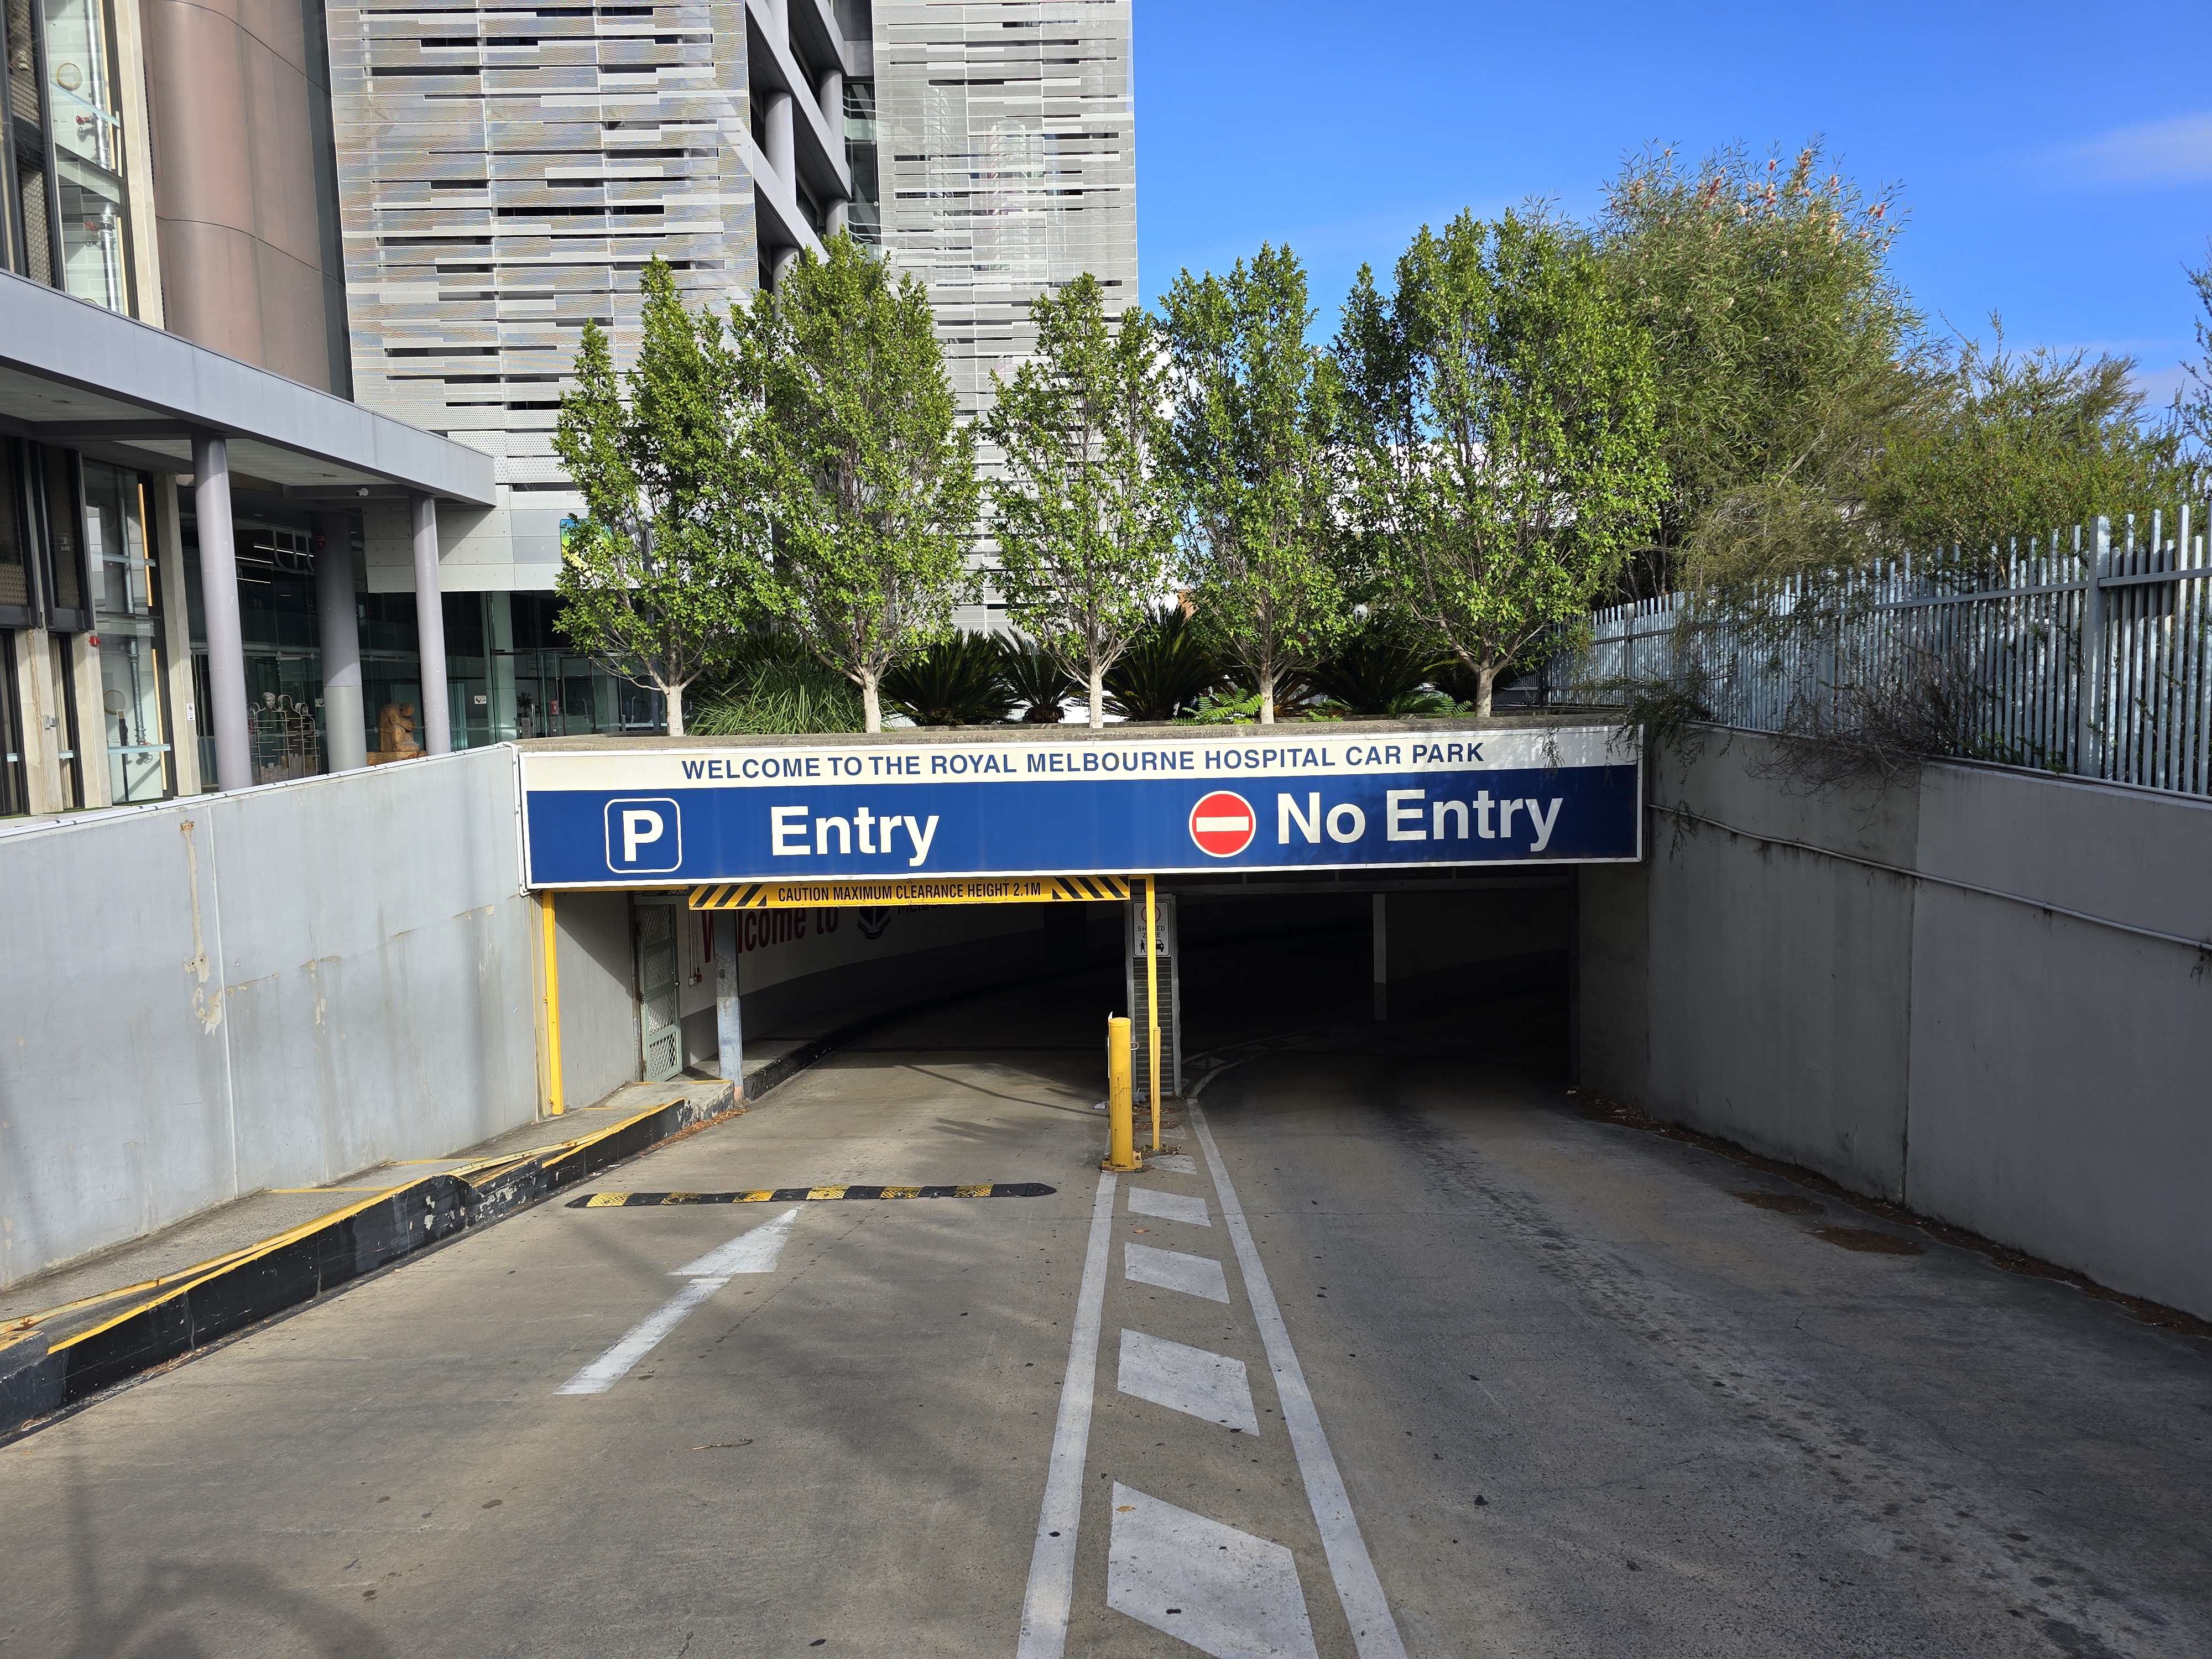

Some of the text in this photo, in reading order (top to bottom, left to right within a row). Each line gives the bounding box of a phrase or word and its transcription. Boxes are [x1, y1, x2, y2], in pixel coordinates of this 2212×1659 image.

[682, 743, 1484, 779] WELCOME TO THE ROYAL MELBOURNE HOSPITAL CAR PARK
[622, 810, 664, 862] P
[771, 806, 940, 867] Entry
[1277, 789, 1563, 852] No Entry
[778, 882, 1041, 901] CAUTION MAXIMUM CLEARANCE HEIGHT 2.1M
[701, 908, 807, 963] lcome
